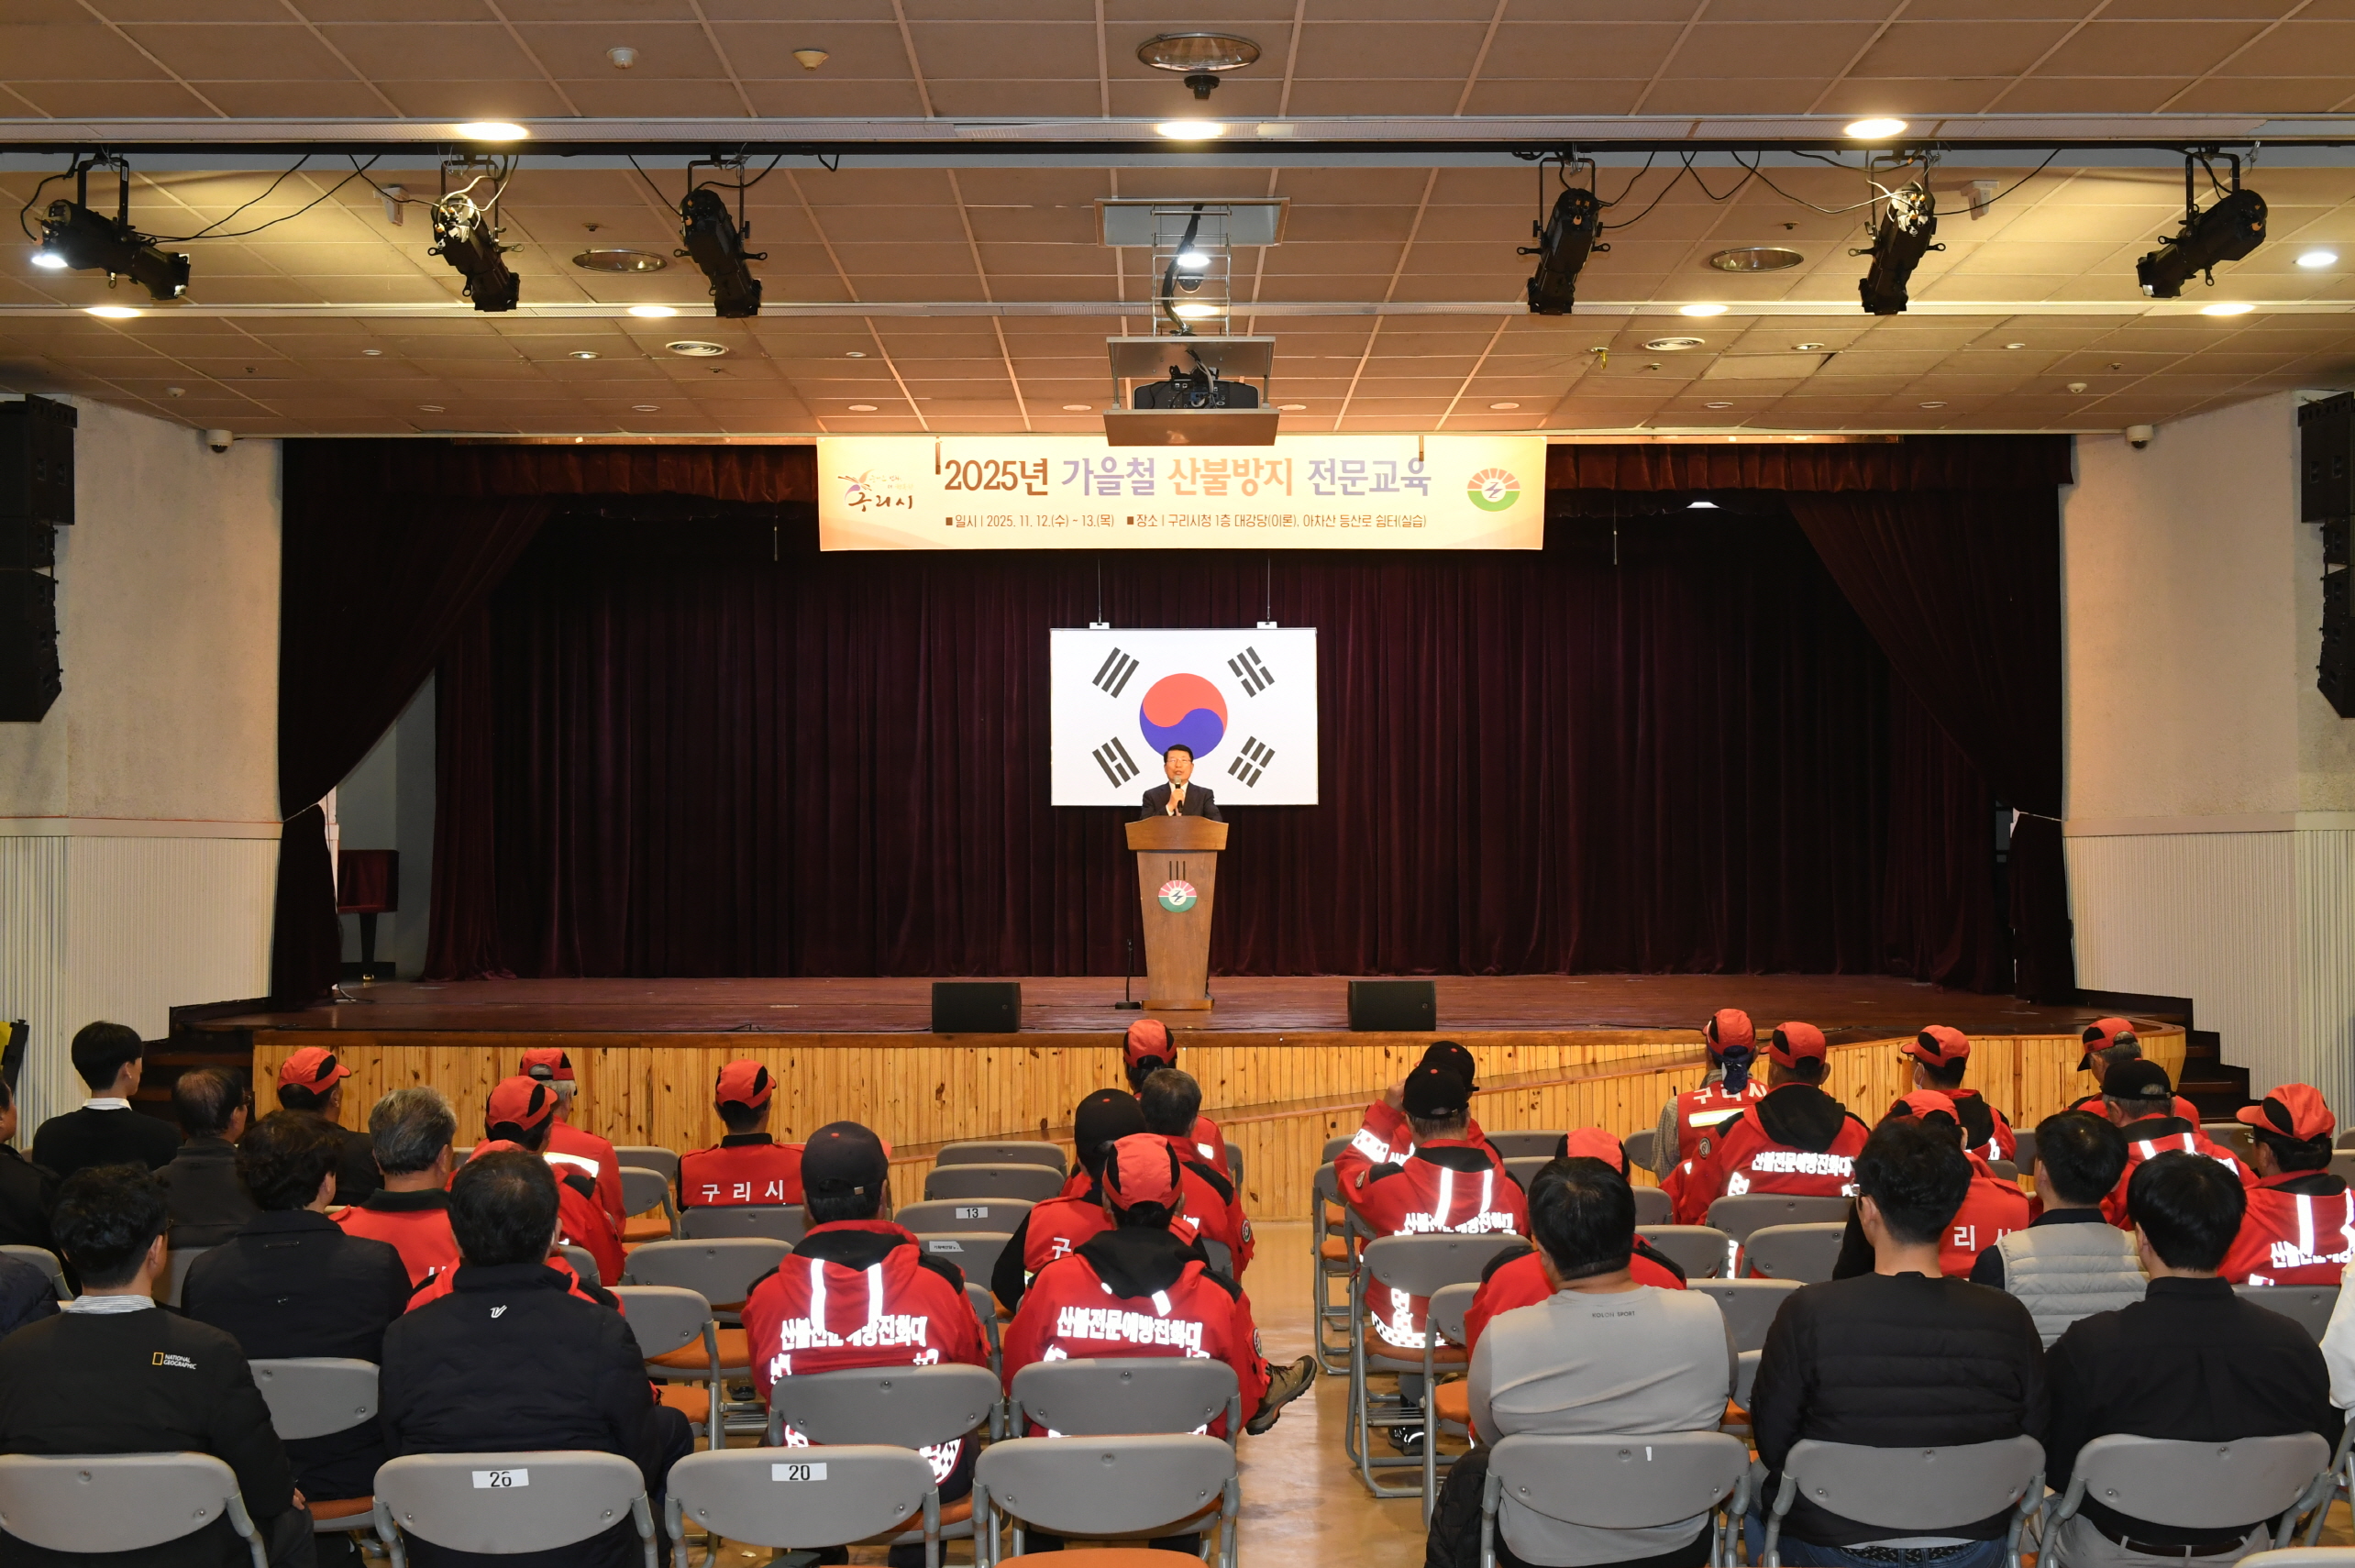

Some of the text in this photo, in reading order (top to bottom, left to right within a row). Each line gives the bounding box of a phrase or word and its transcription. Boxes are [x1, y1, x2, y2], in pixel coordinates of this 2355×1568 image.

[945, 456, 1432, 497] 2025년 가을철 산불방지 전문교육
[848, 491, 913, 513] 구리시
[955, 514, 977, 528] 일시
[987, 514, 1015, 527] 2025.
[1019, 514, 1033, 527] 11.
[1036, 513, 1069, 528] 12.(수)
[1081, 513, 1114, 528] 13.(목)
[1136, 513, 1158, 528] 장소
[1167, 513, 1211, 528] 구리시청
[1215, 513, 1231, 528] 1층
[1302, 513, 1336, 528] 아차산
[1339, 513, 1372, 528] 등산로
[1376, 513, 1427, 528] 쉼터(실습)
[966, 1208, 979, 1219] 13
[1056, 1306, 1203, 1352] 산불전문예방진화대
[163, 1359, 198, 1370] GEOGRAPHIC
[164, 1353, 192, 1364] NATIONAL
[489, 1471, 513, 1487] 26
[789, 1464, 811, 1481] 20
